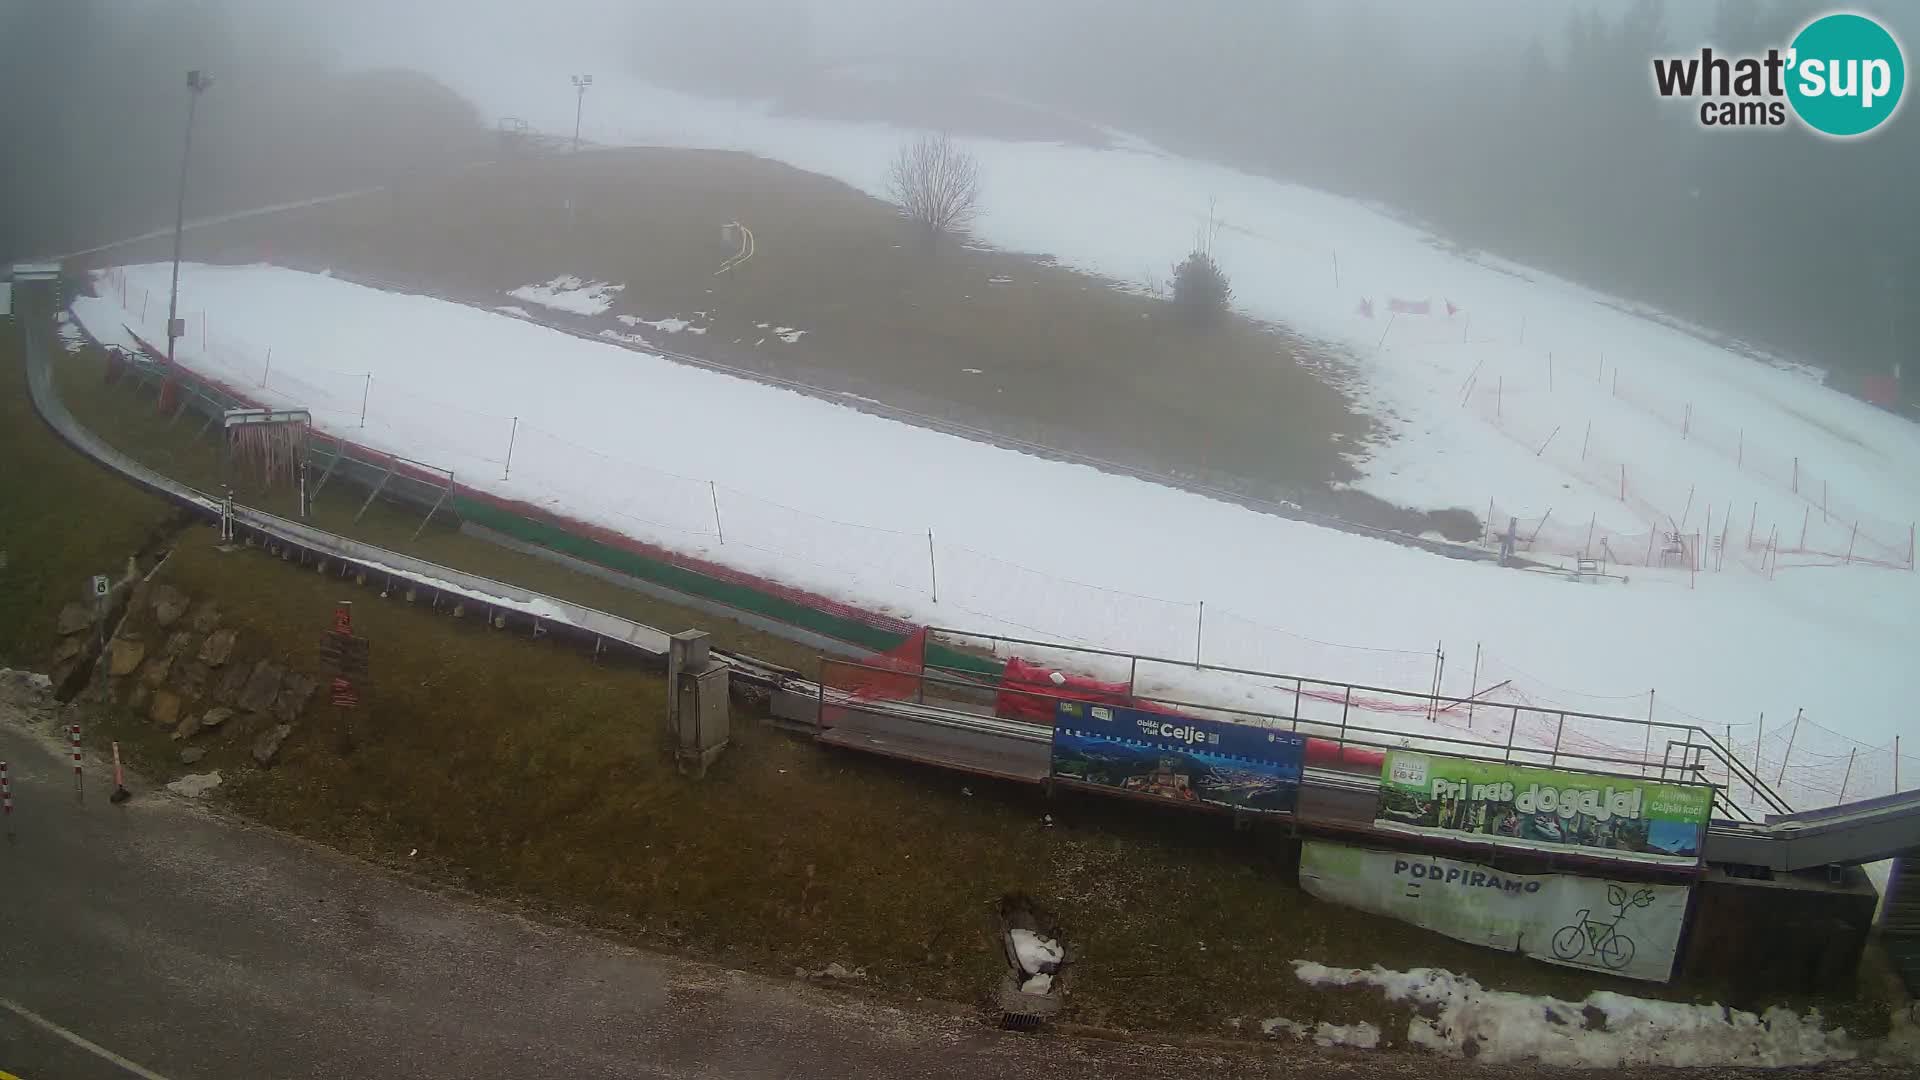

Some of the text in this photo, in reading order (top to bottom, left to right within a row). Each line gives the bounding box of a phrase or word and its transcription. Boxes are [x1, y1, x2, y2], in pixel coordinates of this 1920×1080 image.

[1160, 723, 1206, 745] Celje
[1431, 778, 1468, 801] Pri
[1471, 781, 1514, 802] nas
[1394, 859, 1541, 893] PODPIRAMO
